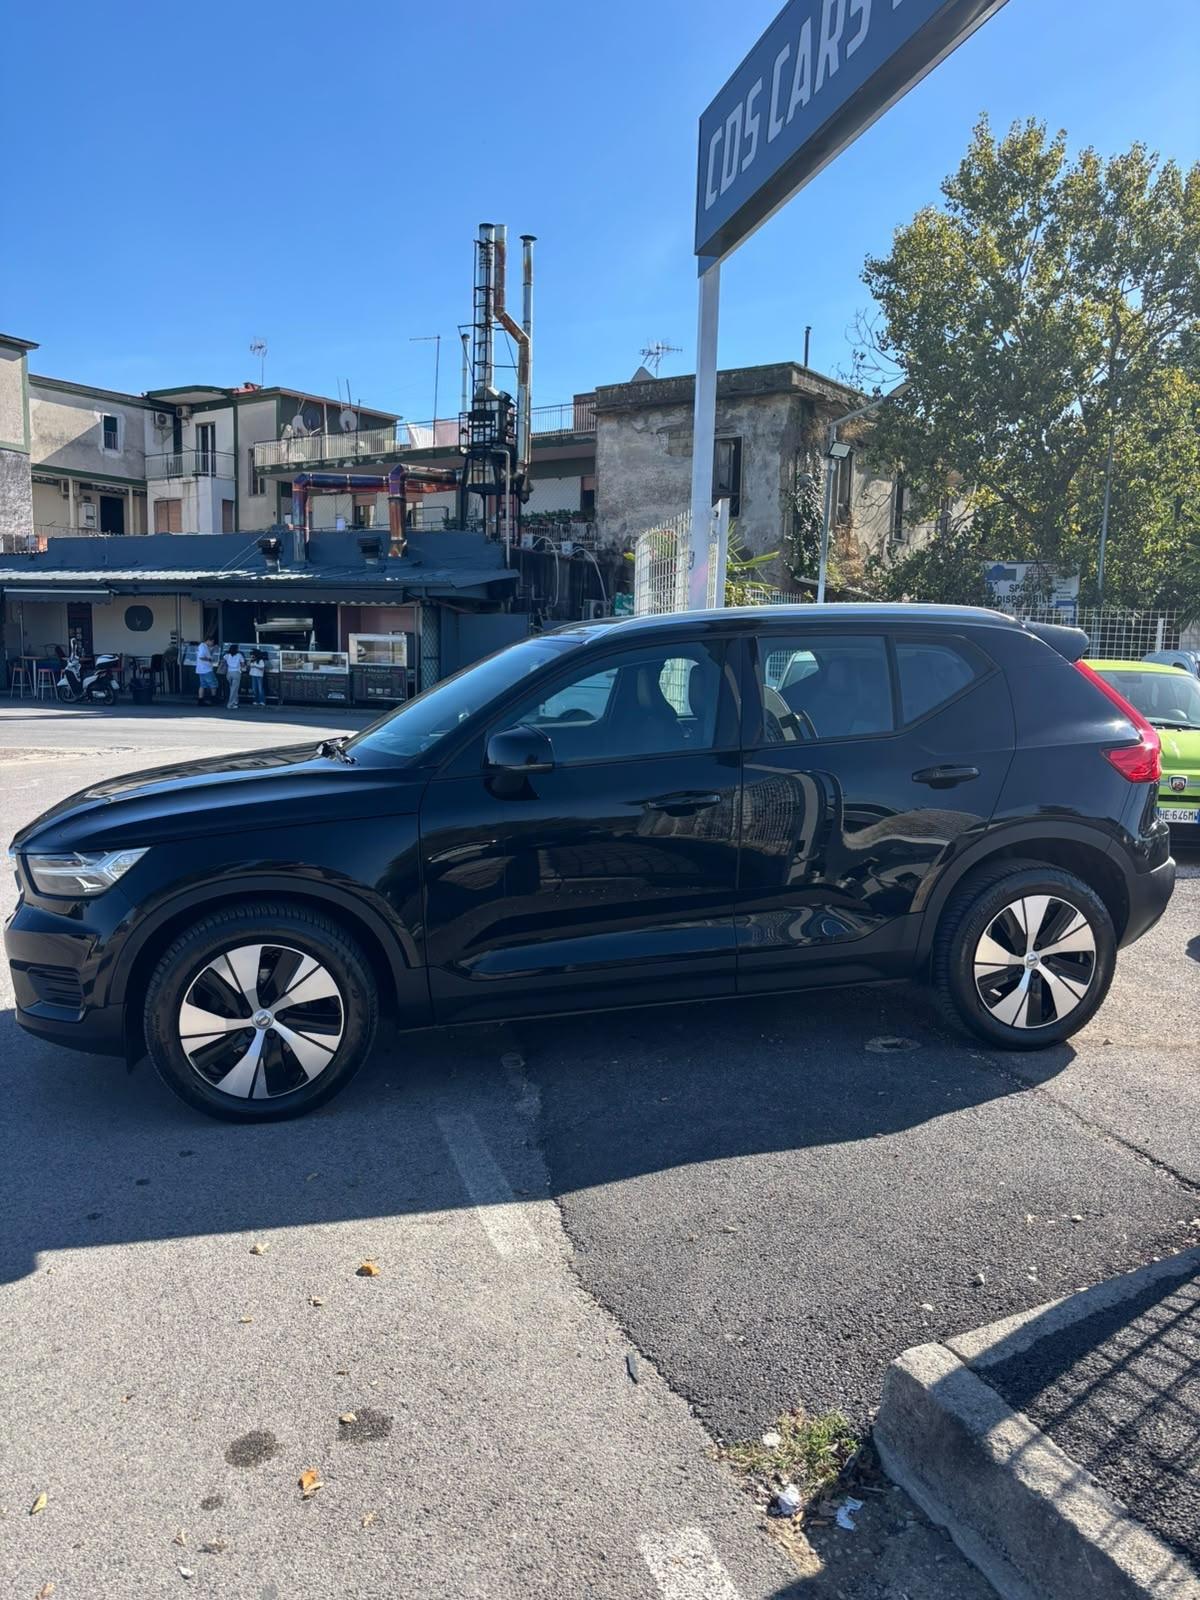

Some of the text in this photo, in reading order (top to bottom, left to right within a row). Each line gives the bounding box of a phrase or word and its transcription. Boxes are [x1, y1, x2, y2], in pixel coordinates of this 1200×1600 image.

[705, 0, 872, 211] COS CARS
[997, 594, 1052, 603] DISPOBILE
